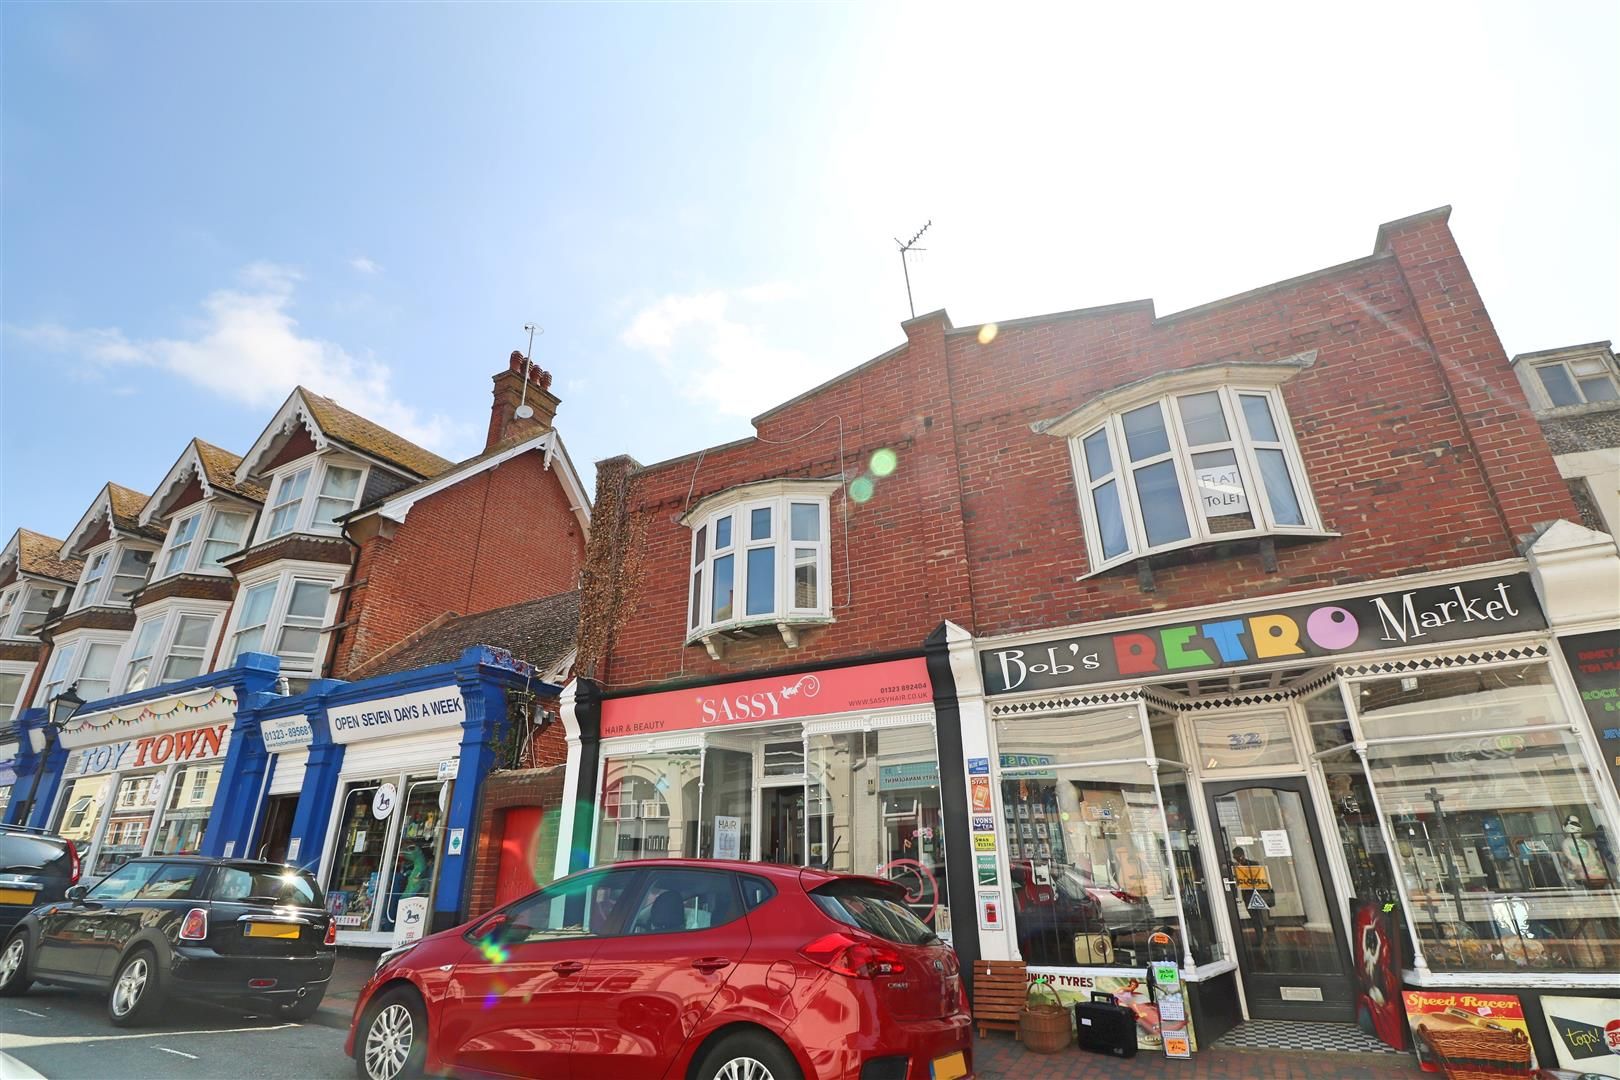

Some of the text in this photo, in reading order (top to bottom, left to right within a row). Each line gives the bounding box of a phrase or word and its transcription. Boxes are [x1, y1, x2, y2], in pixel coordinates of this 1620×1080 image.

[1201, 472, 1236, 488] FLAT
[1223, 493, 1240, 505] LET
[994, 583, 1519, 690] Bob's RETRO Market
[880, 682, 927, 694] 01323 892404
[1583, 689, 1616, 700] ROCK
[848, 692, 928, 706] WWW.SASSYHAIR.CO.UK
[335, 697, 463, 730] OPEN SEVEN DAYS A WEEK
[702, 692, 780, 723] SASSY
[605, 725, 623, 734] HAIR
[626, 724, 631, 732] &
[633, 720, 664, 731] BEAUTY
[80, 725, 228, 775] TOY TOWN
[718, 820, 737, 830] HAIR
[1025, 973, 1094, 988] UNOP TYRES
[1407, 994, 1518, 1008] Speed Racer
[1565, 1028, 1600, 1052] tops!
